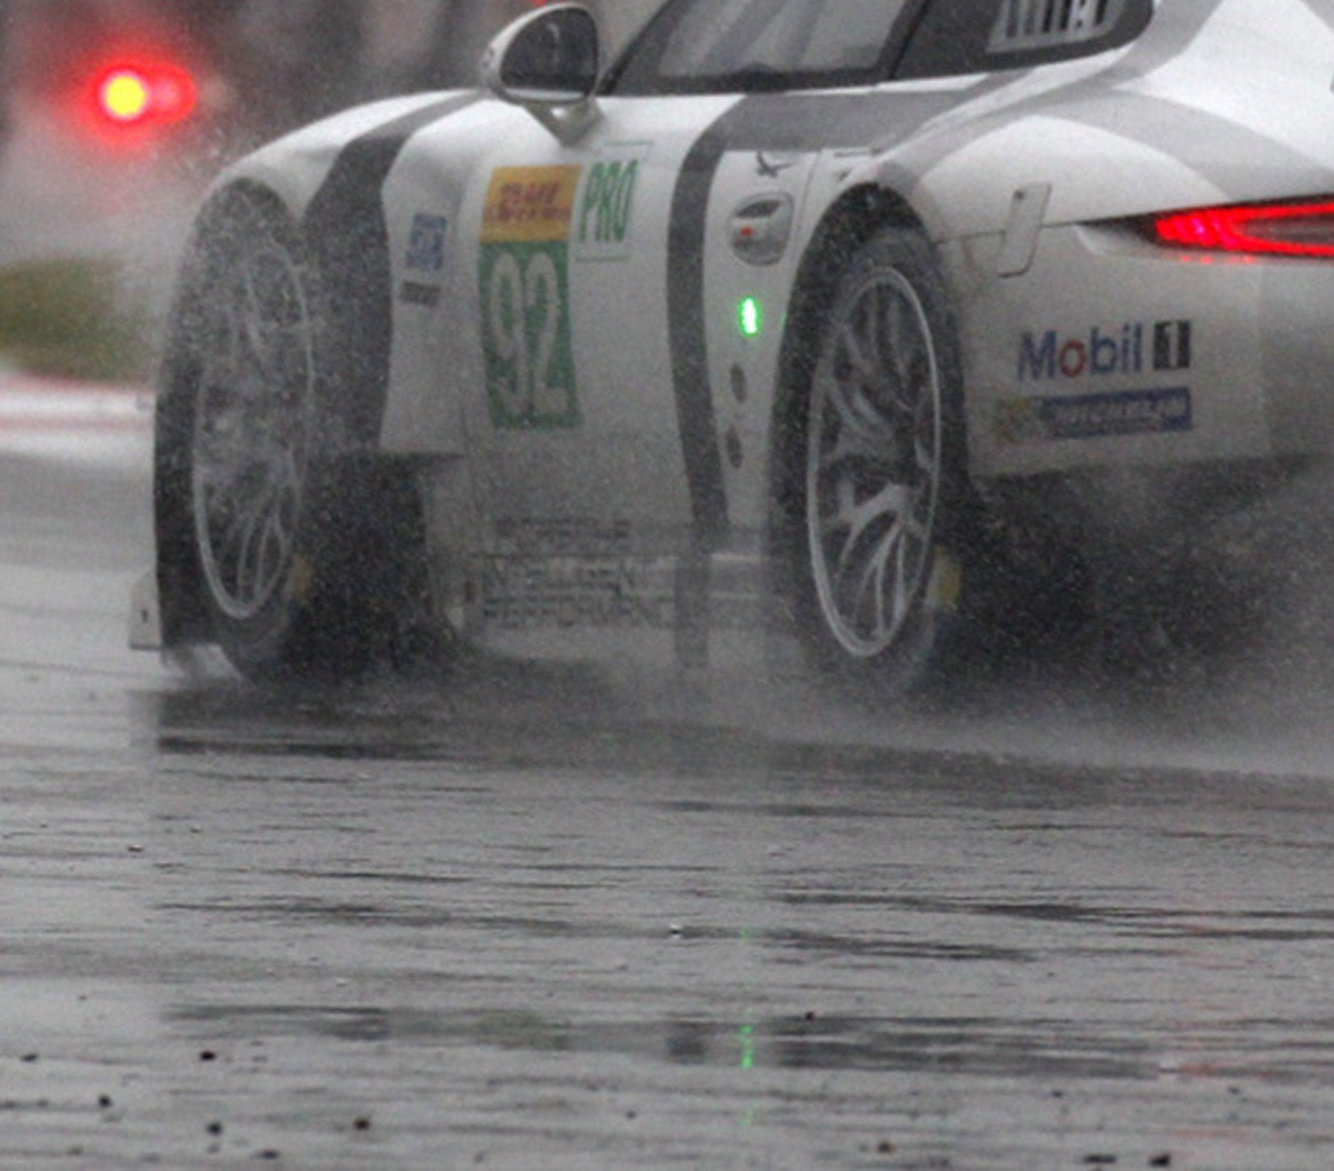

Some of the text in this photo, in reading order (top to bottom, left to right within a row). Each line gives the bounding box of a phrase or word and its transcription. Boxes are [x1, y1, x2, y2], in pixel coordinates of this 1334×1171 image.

[579, 159, 638, 243] PRO
[489, 251, 568, 416] 92
[1016, 322, 1184, 382] Mobil 1
